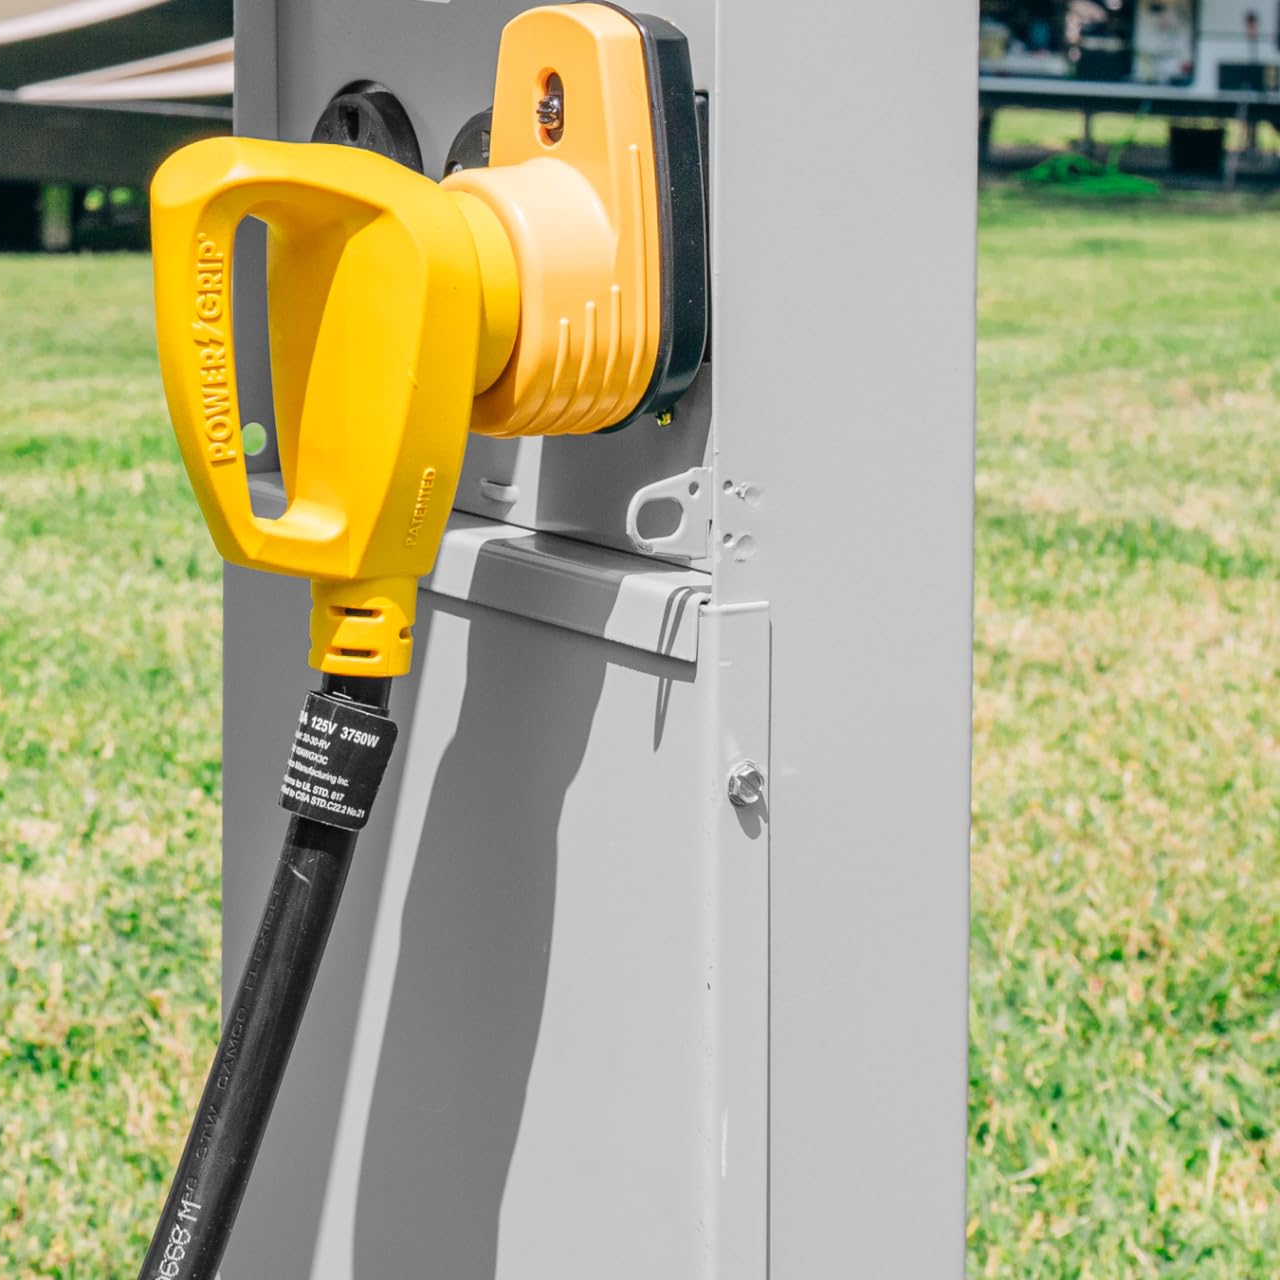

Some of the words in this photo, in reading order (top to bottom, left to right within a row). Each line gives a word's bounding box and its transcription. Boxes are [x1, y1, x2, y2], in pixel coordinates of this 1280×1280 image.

[200, 348, 237, 467] POWER
[405, 467, 437, 549] PATENTED
[311, 715, 338, 735] 125V
[340, 726, 381, 748] 3750W
[295, 761, 337, 785] Manufacturing
[337, 776, 349, 786] Inc.
[295, 791, 310, 804] CSA
[302, 781, 311, 793] UL
[313, 785, 329, 799] STD.
[331, 791, 345, 801] 817
